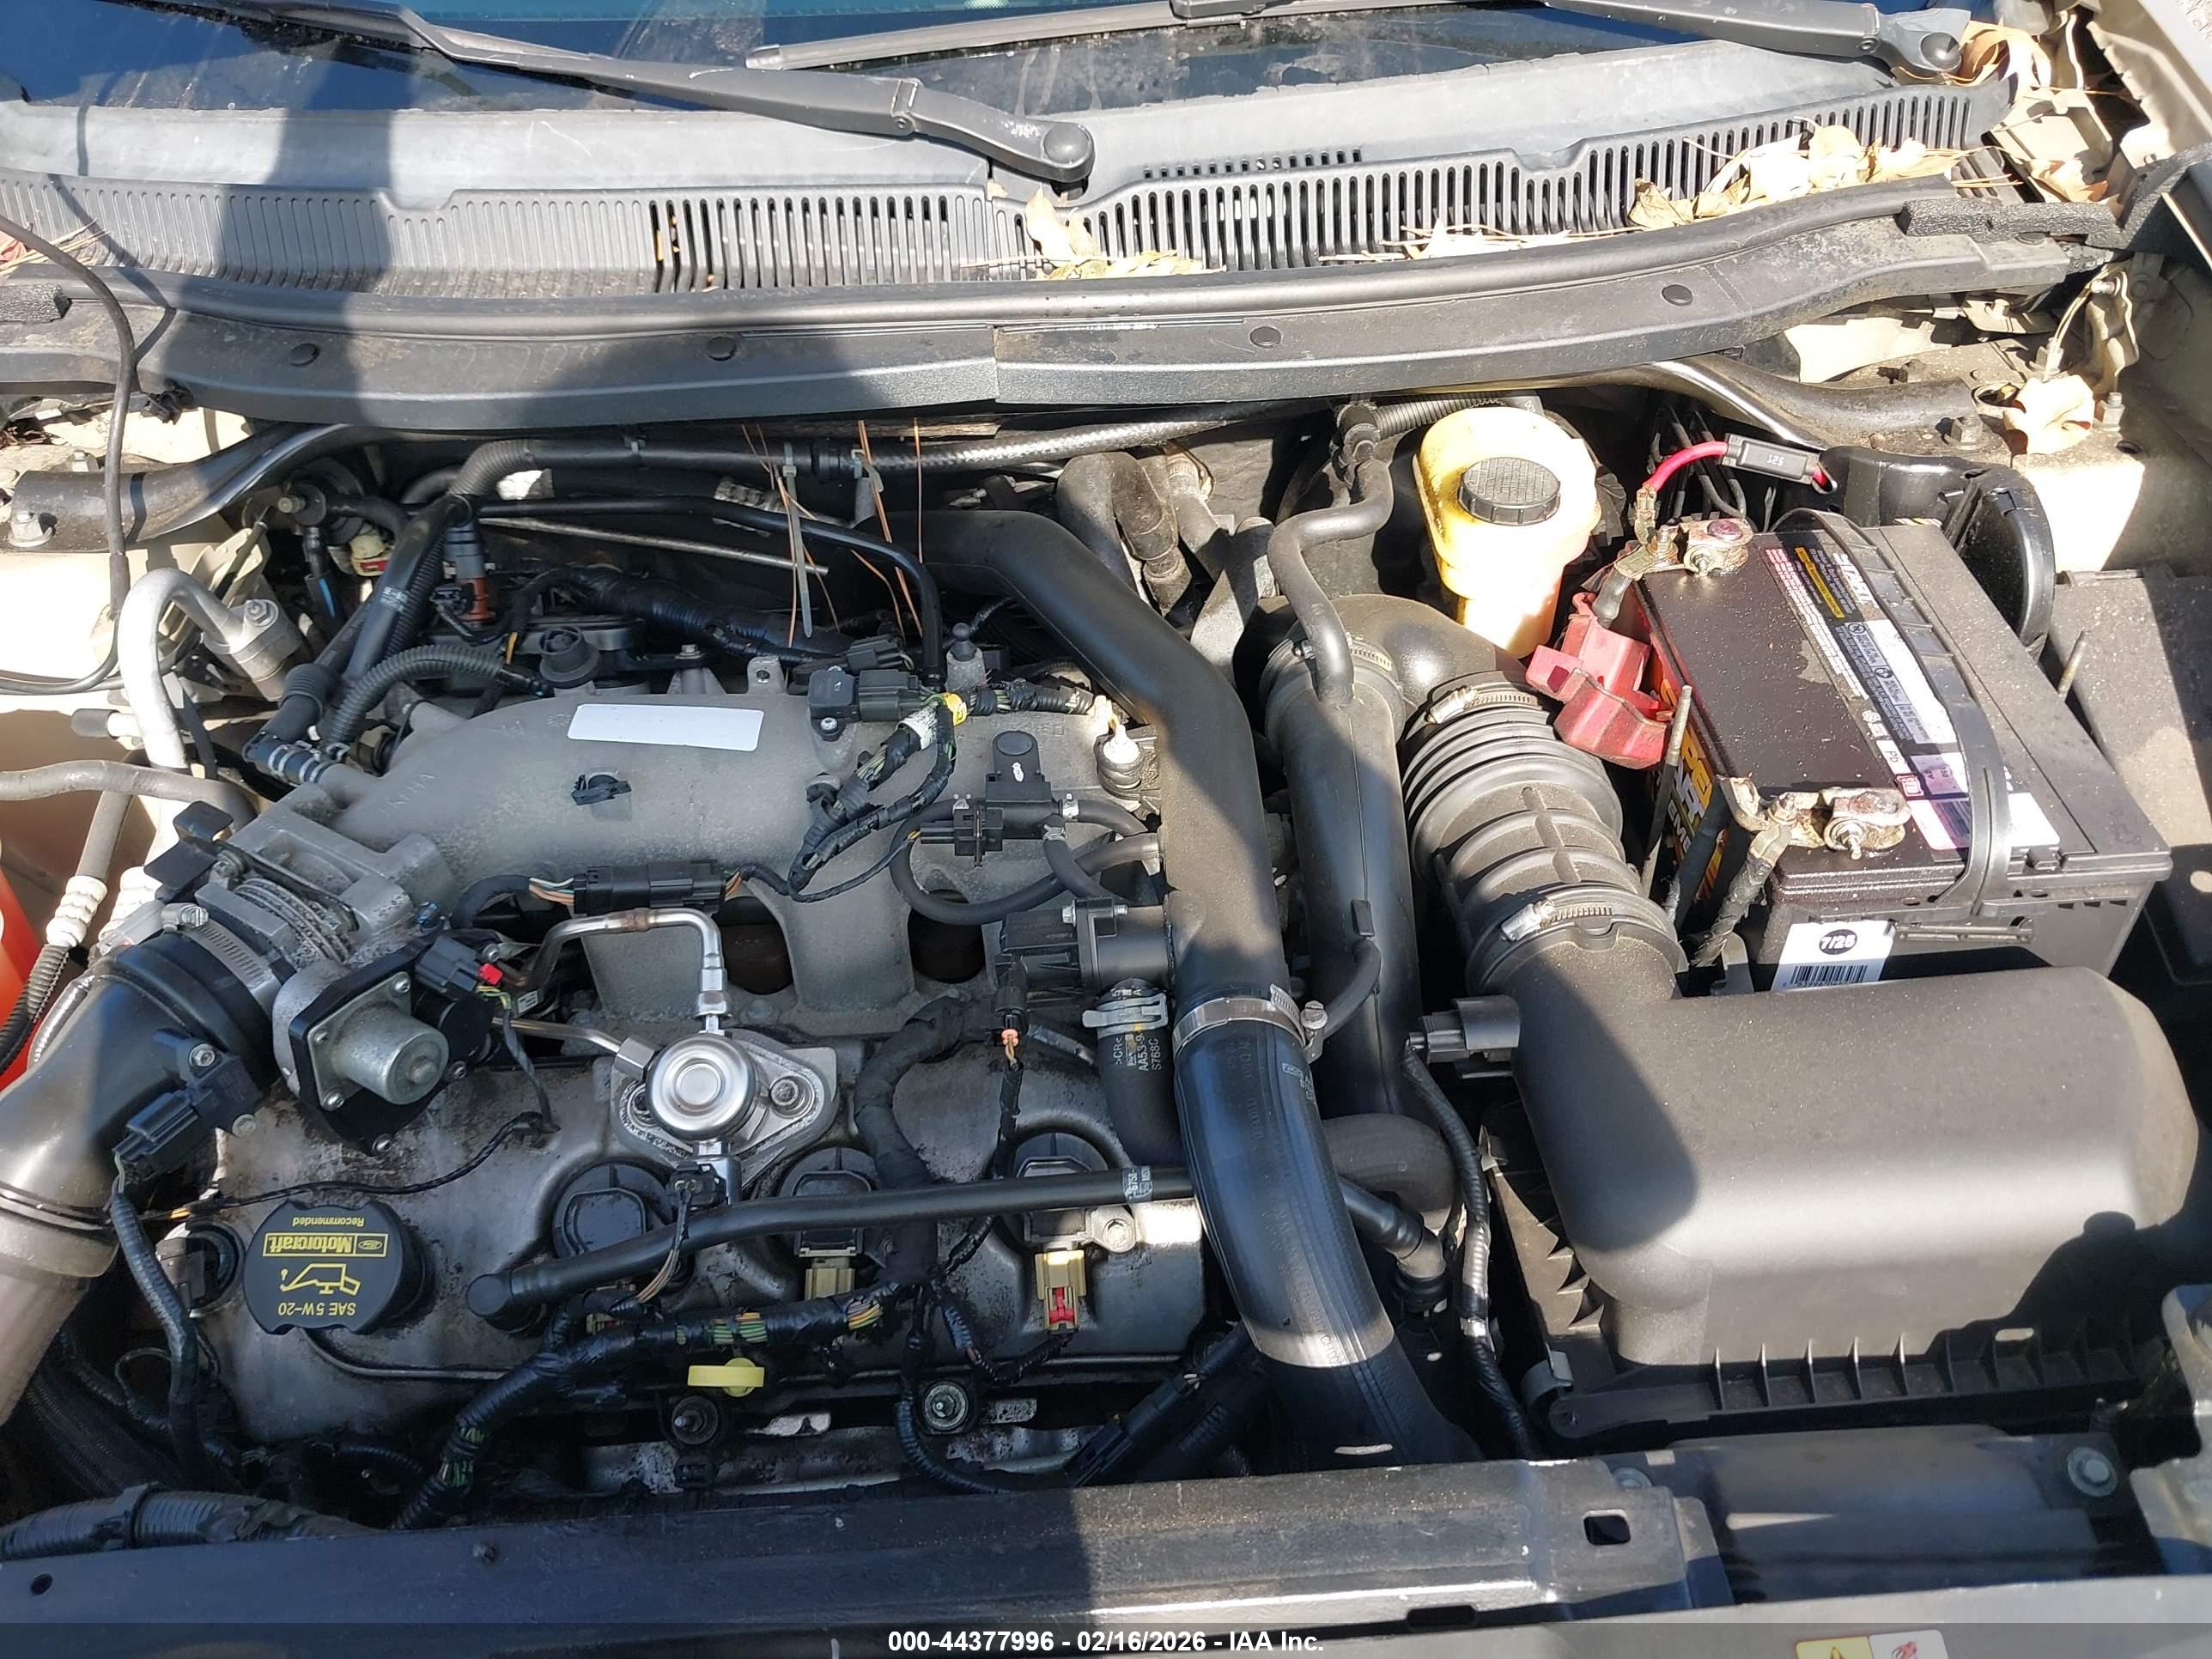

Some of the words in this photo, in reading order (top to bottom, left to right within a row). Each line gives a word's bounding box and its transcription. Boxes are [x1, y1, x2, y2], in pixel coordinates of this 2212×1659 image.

[1885, 750, 1899, 763] Pb
[292, 1216, 365, 1228] Recommended
[268, 1236, 353, 1254] Motorcraft
[358, 1240, 383, 1250] Ford
[277, 1302, 325, 1316] 5W-20
[329, 1302, 356, 1316] SAE
